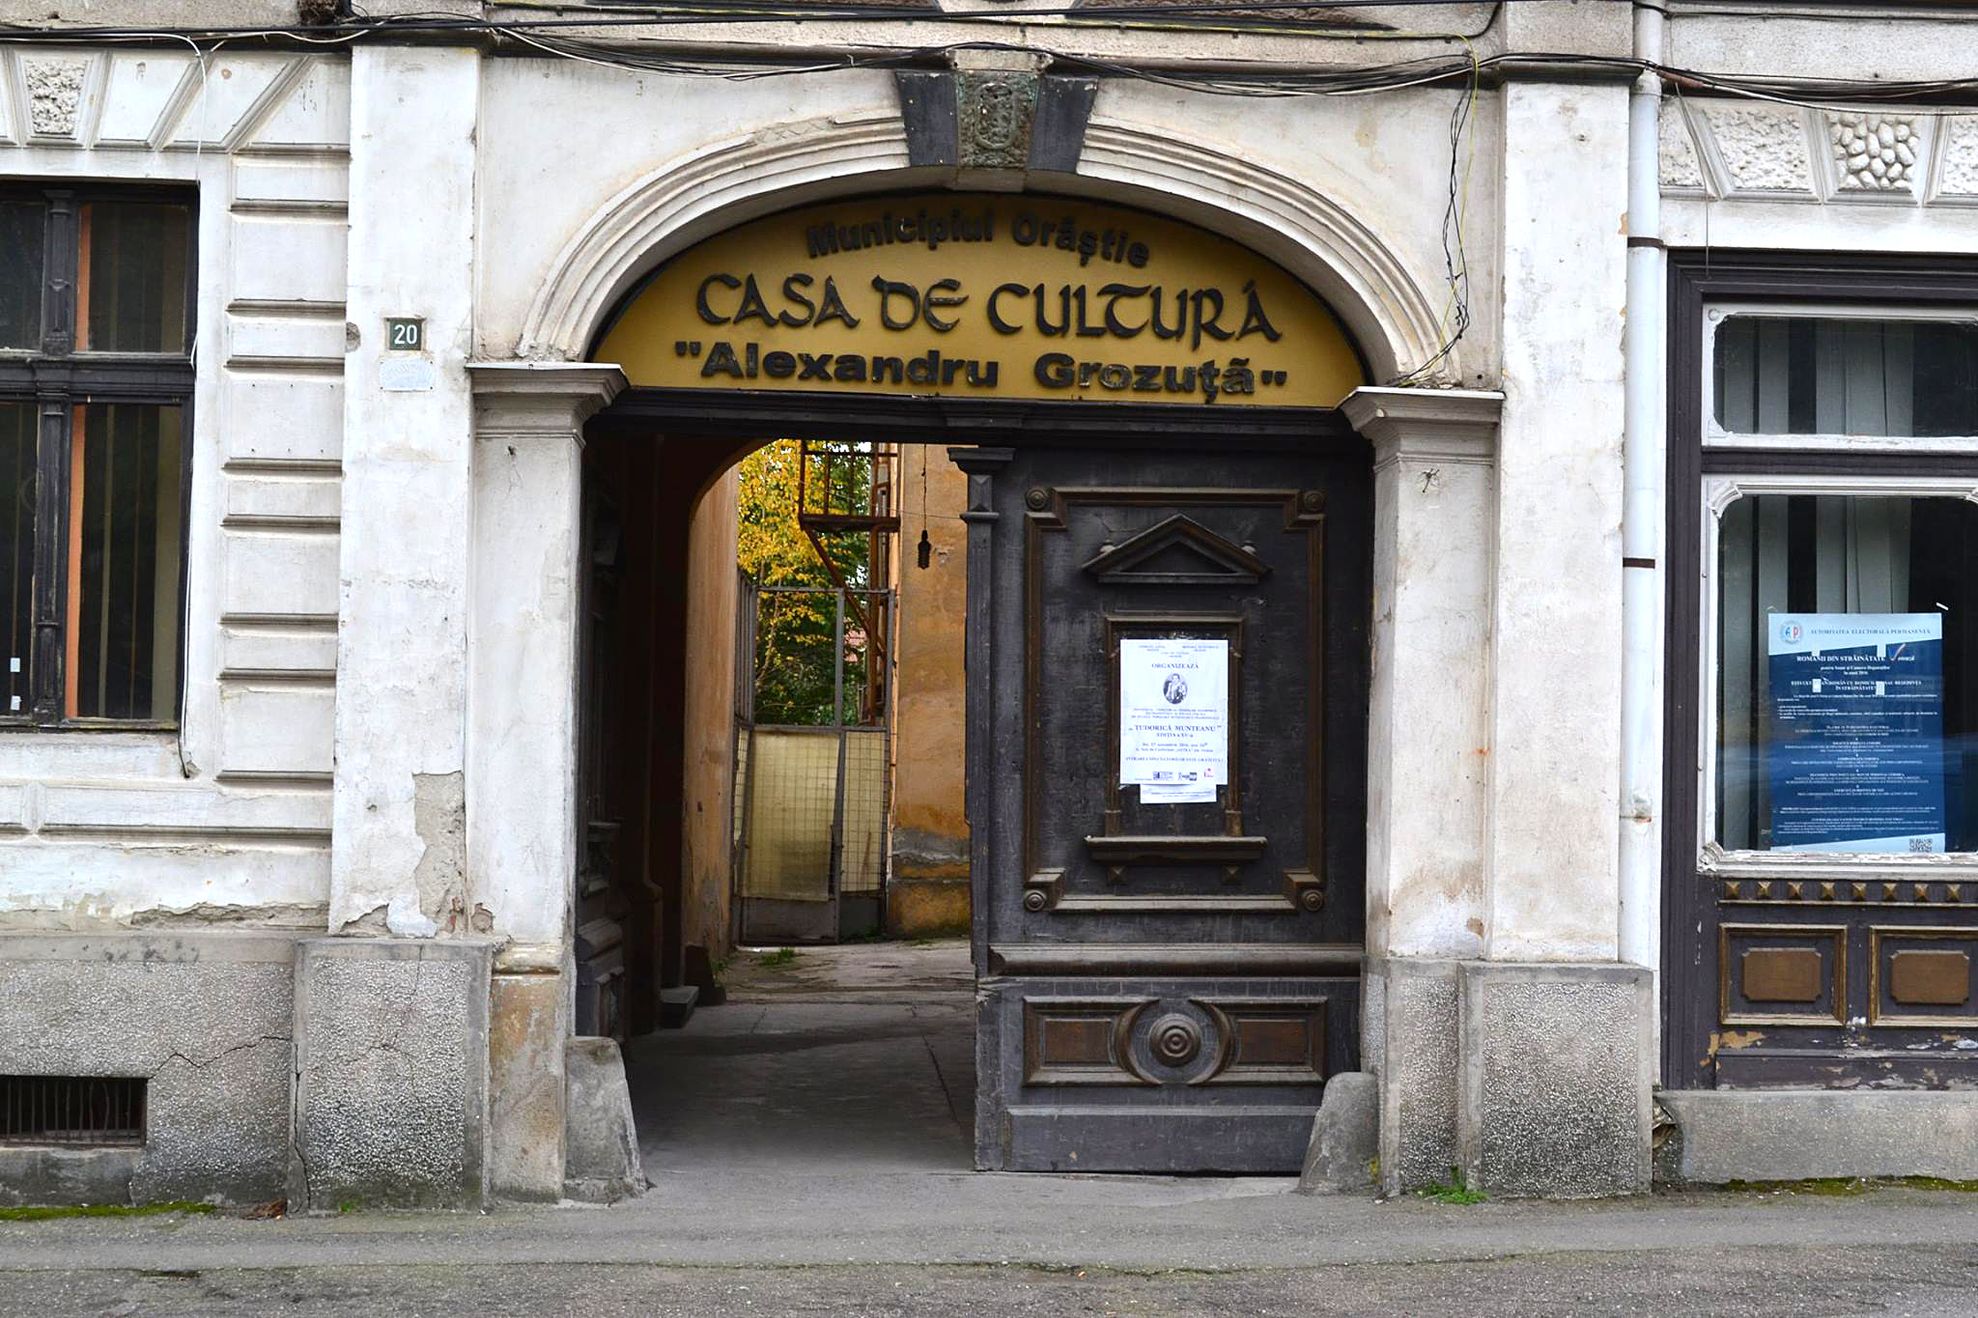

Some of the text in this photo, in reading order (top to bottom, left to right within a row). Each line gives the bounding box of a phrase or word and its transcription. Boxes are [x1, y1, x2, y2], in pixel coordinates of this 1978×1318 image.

[806, 209, 996, 259] Municipiul
[696, 272, 861, 329] CASA
[871, 274, 969, 333] DE
[394, 324, 418, 345] 20
[674, 340, 999, 387] "Alexandru
